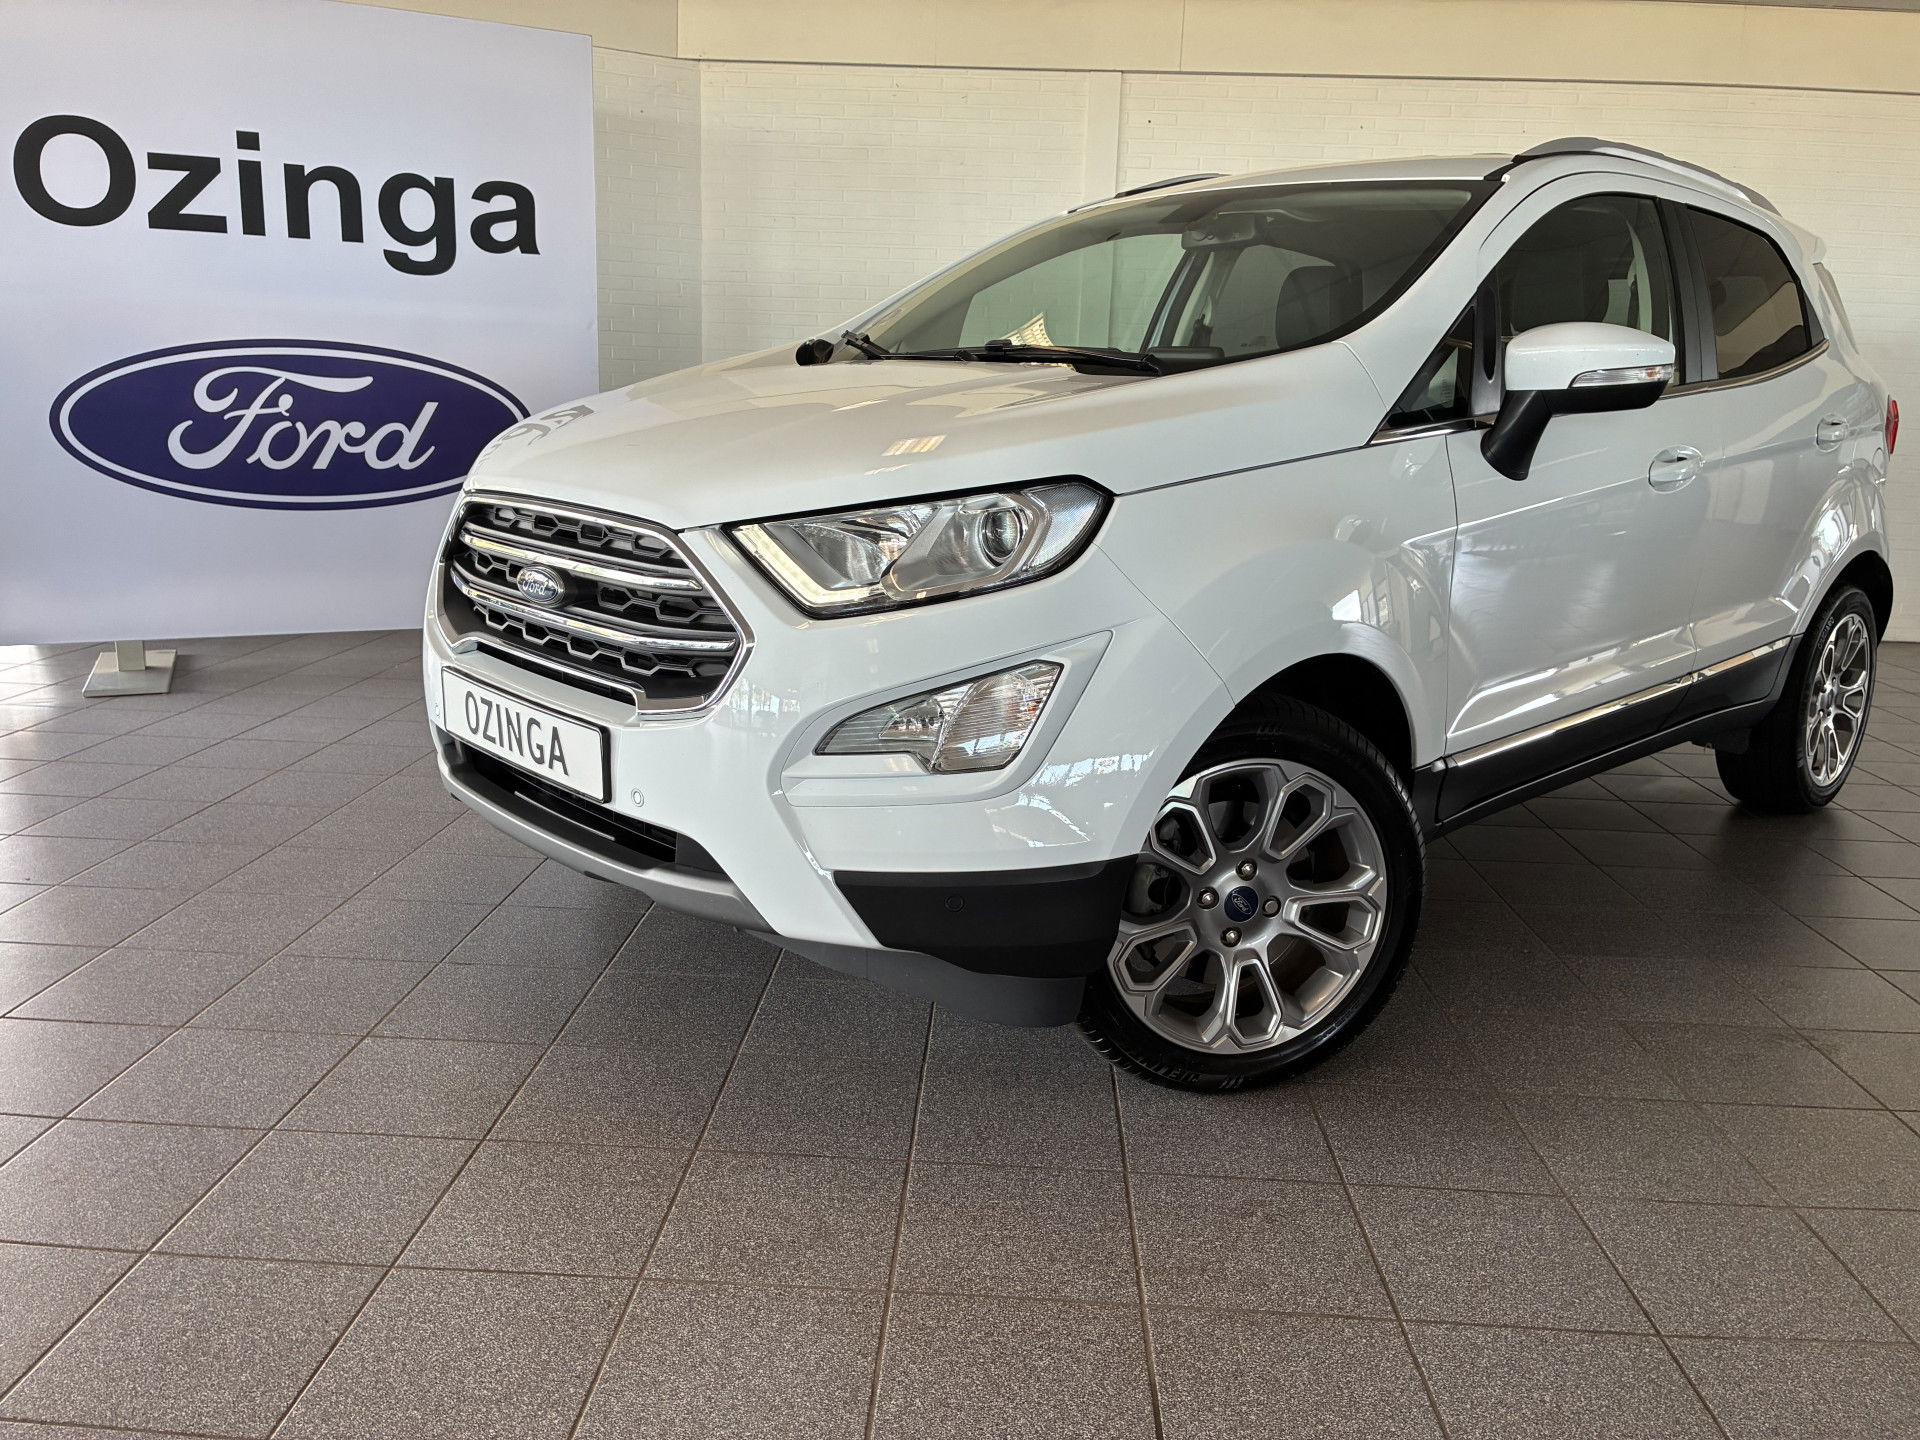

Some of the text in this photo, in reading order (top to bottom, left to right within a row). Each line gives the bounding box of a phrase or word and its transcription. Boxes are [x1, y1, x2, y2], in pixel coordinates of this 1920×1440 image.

[13, 114, 540, 276] Ozinga
[167, 365, 439, 470] Ford
[464, 690, 570, 777] OZINGA
